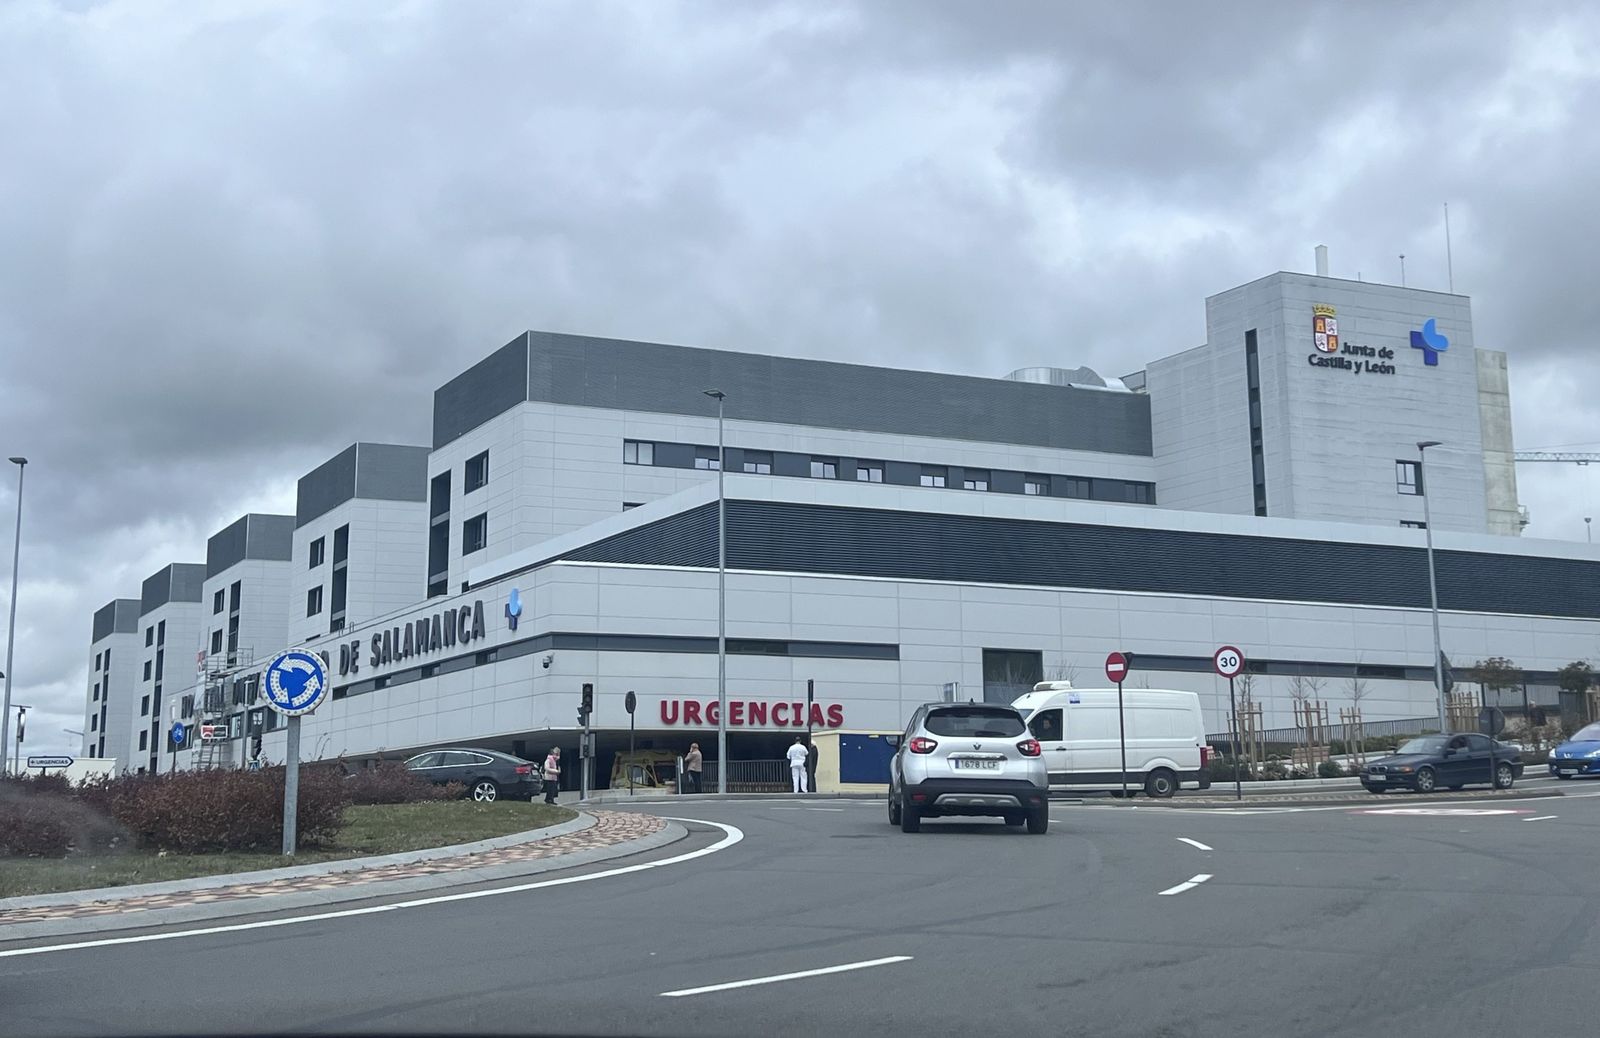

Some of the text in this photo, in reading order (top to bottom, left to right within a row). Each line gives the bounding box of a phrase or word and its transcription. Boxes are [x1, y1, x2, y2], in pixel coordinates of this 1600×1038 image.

[1341, 342, 1394, 359] Junta de
[1308, 353, 1395, 375] Castilla y León
[339, 600, 486, 676] DE SALAMANCA
[1220, 656, 1237, 668] 30
[660, 700, 844, 728] URGENCIAS
[960, 760, 981, 769] 1678
